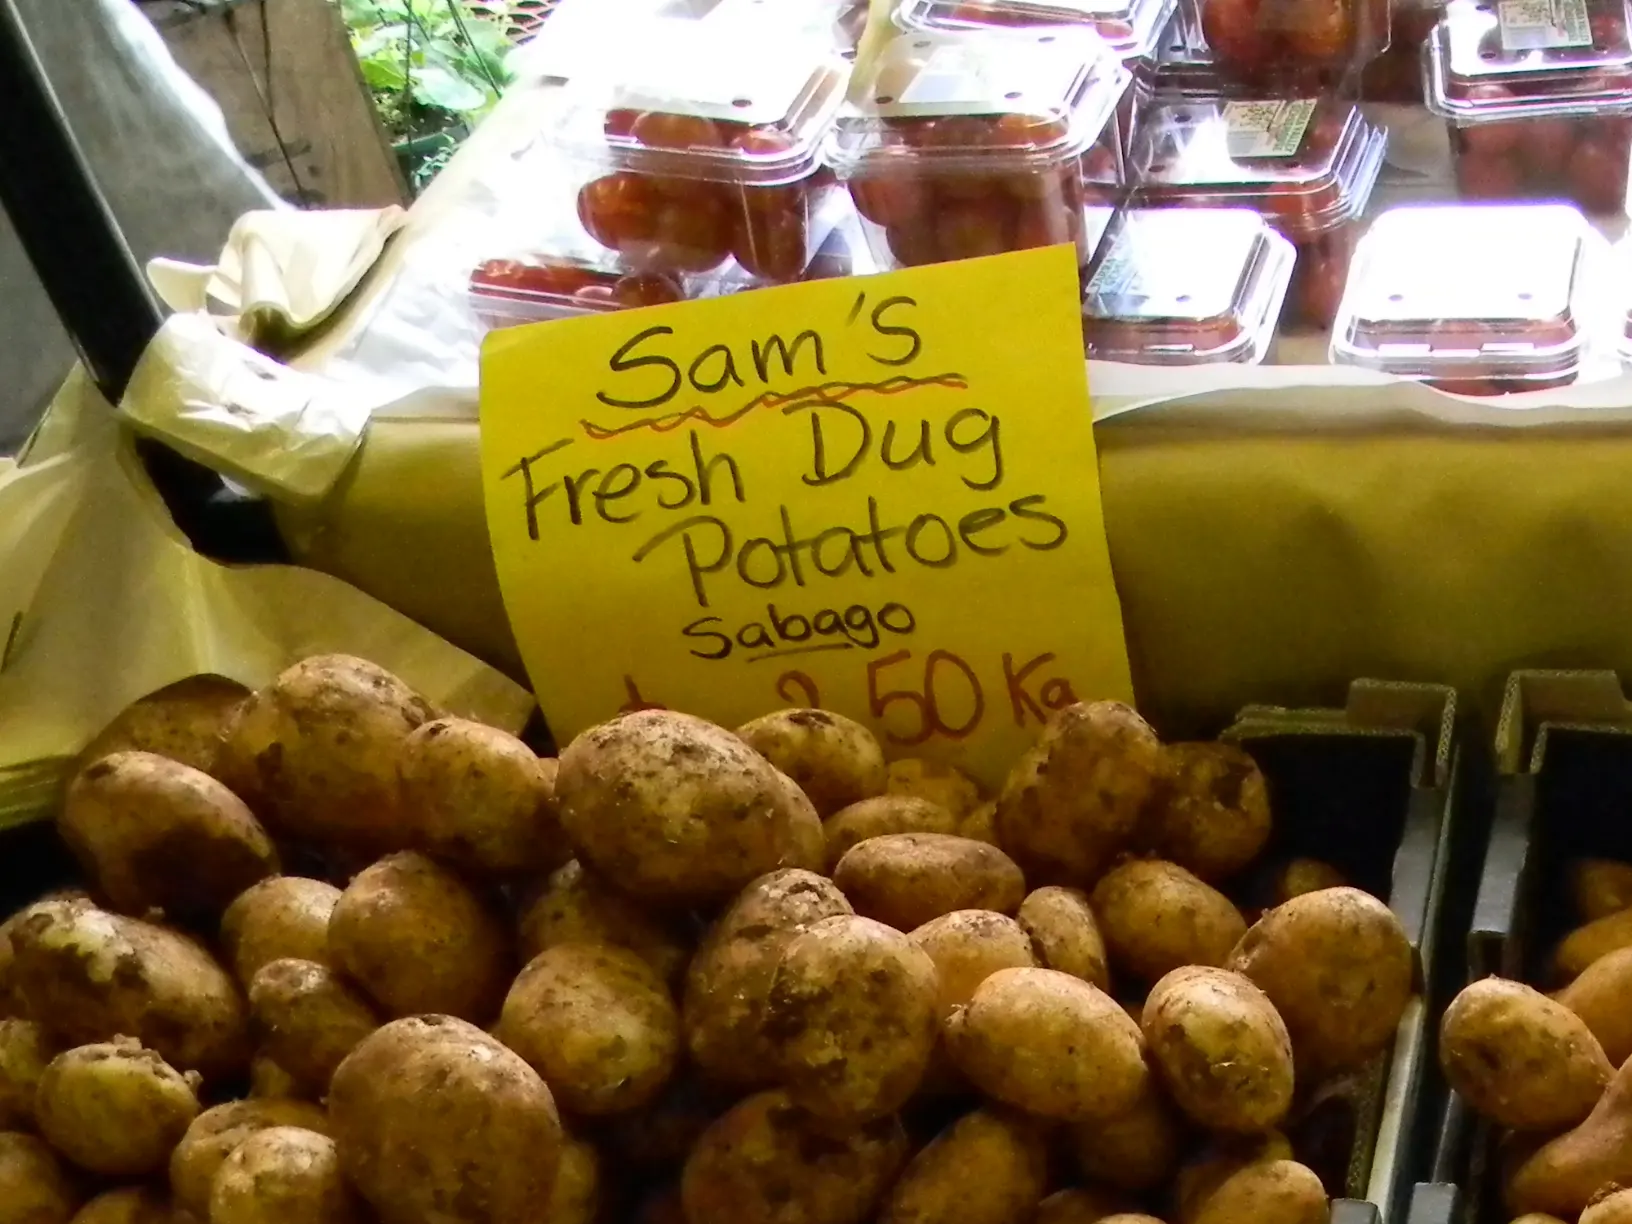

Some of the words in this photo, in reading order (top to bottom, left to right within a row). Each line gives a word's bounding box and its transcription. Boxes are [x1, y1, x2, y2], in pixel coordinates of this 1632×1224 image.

[596, 291, 922, 409] Sam's
[500, 430, 746, 541] Fresh
[781, 397, 1003, 491] Dug
[631, 494, 1069, 607] Potatoes
[682, 600, 917, 660] Sabago
